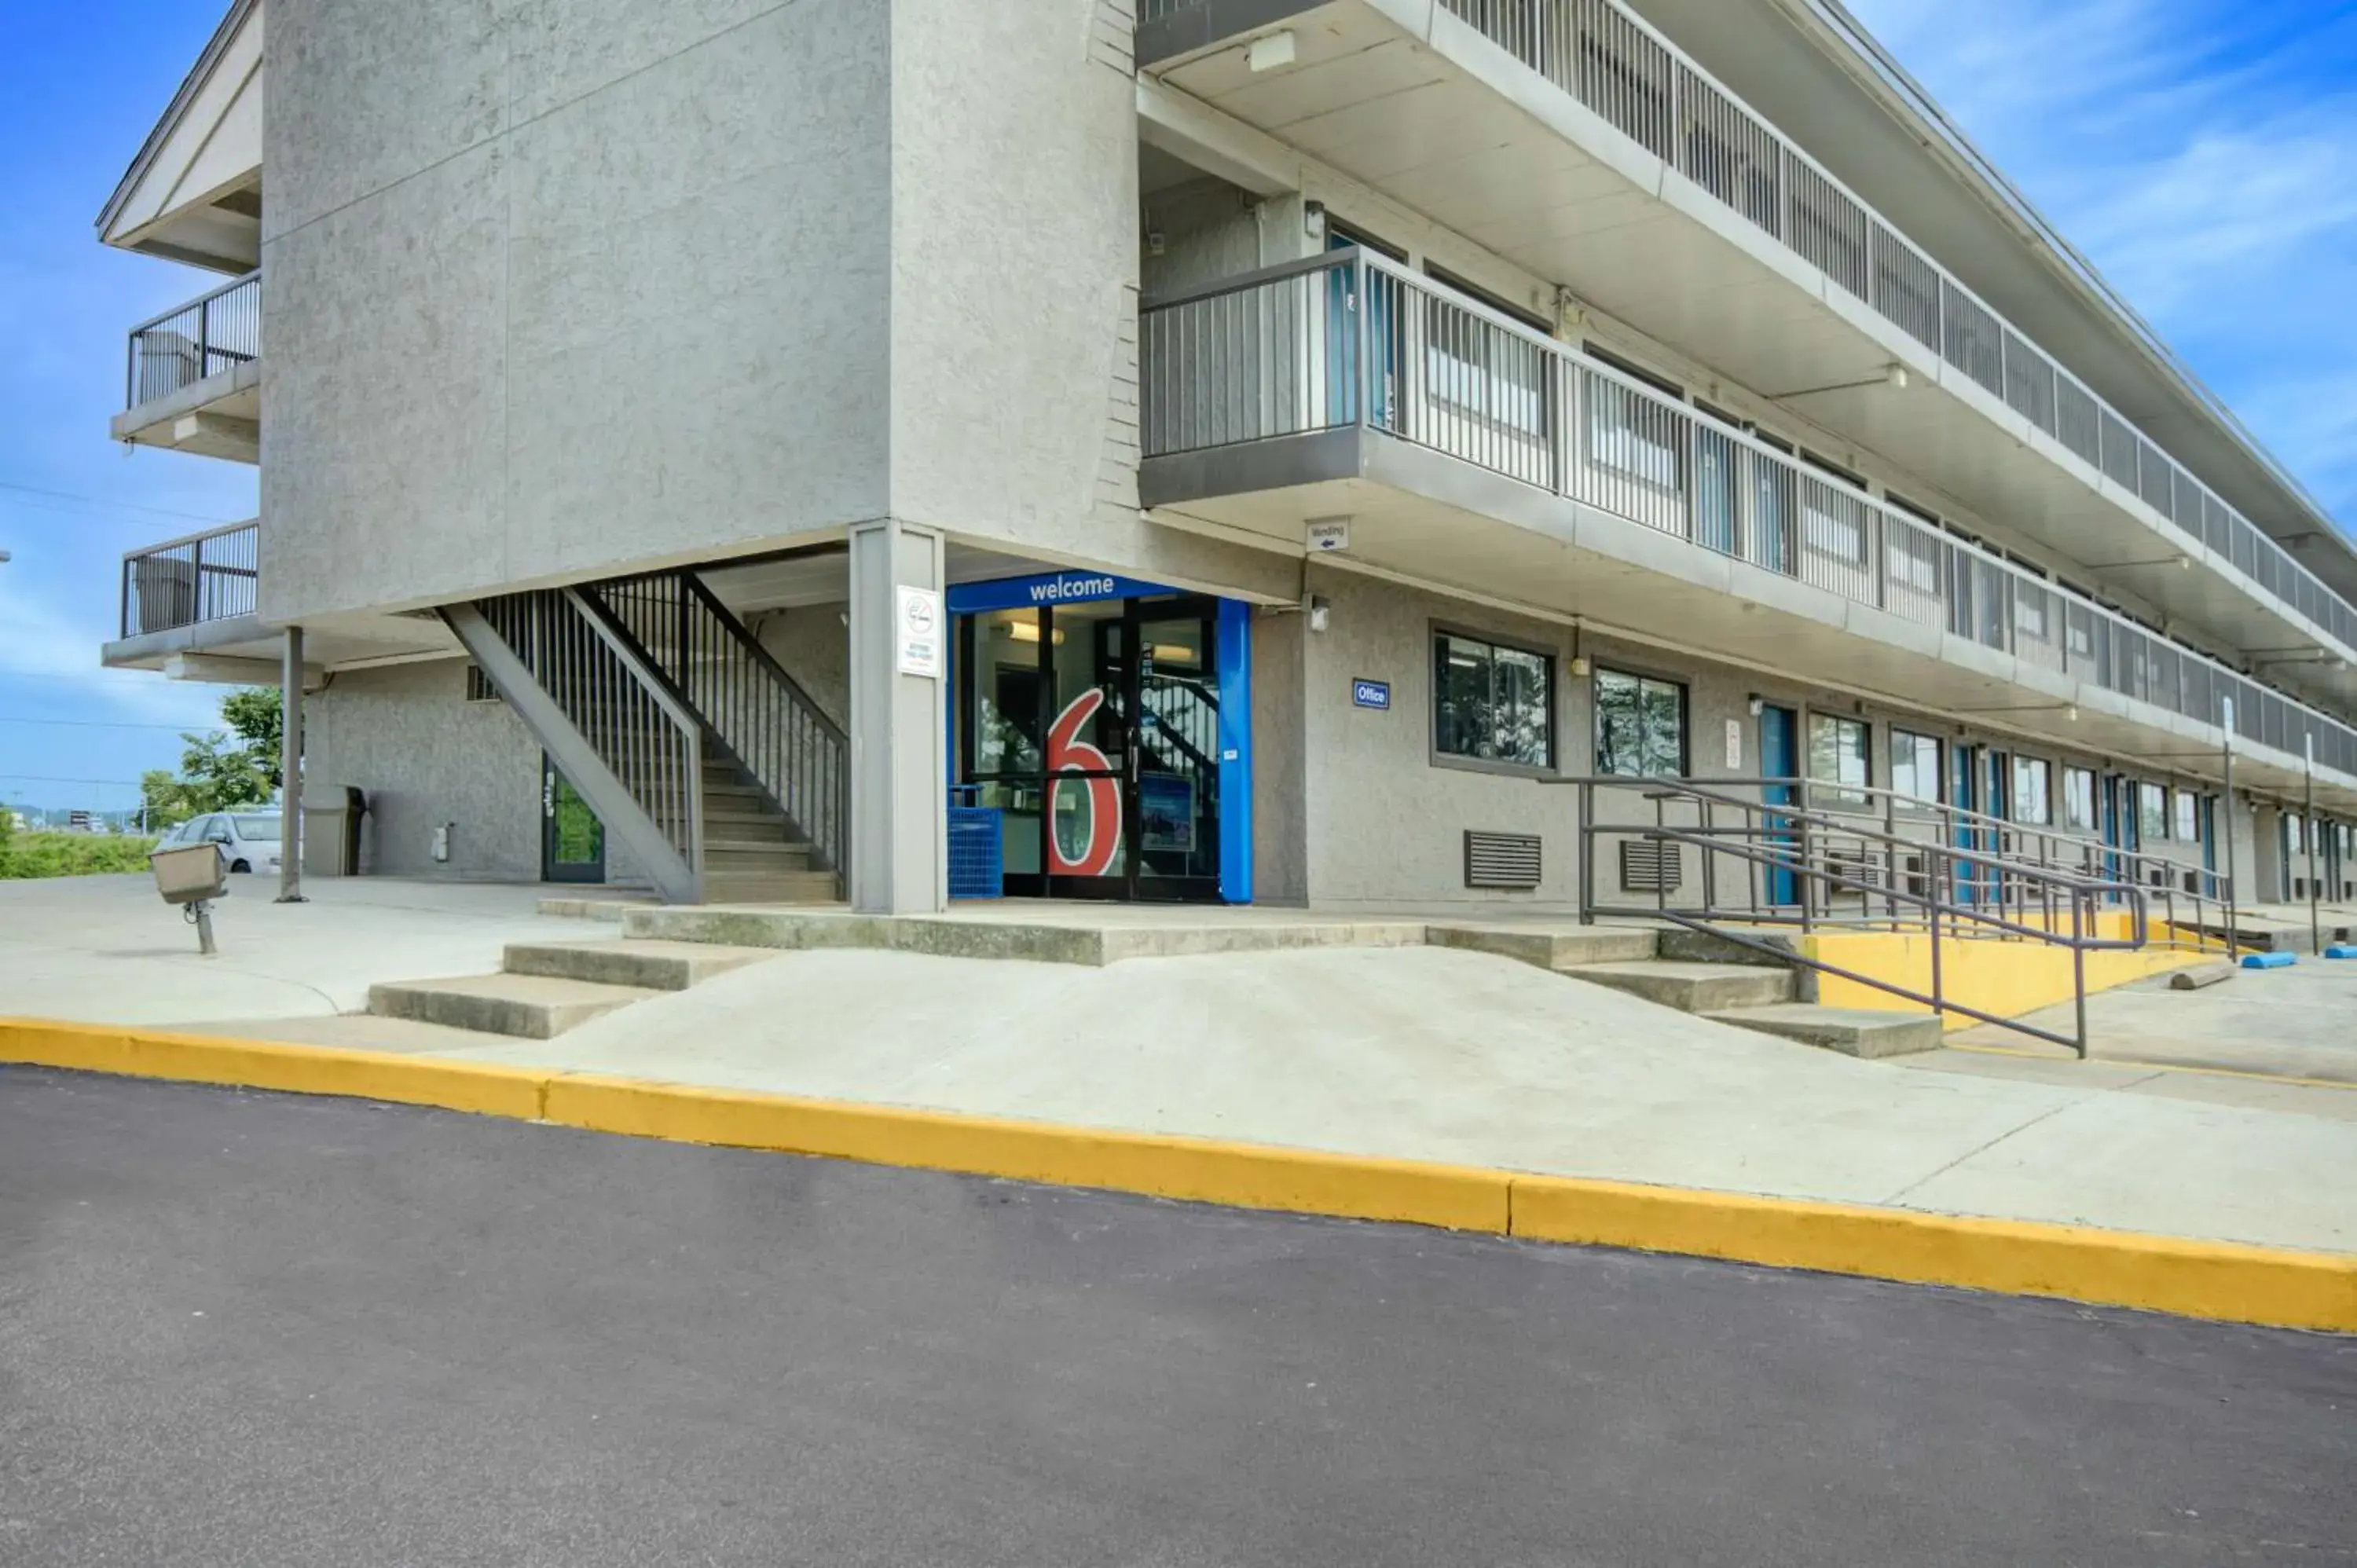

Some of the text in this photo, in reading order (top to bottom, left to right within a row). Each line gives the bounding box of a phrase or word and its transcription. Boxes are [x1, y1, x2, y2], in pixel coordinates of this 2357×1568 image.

[1030, 574, 1114, 601] welcome
[1358, 686, 1385, 703] Office
[1047, 687, 1123, 875] 6
